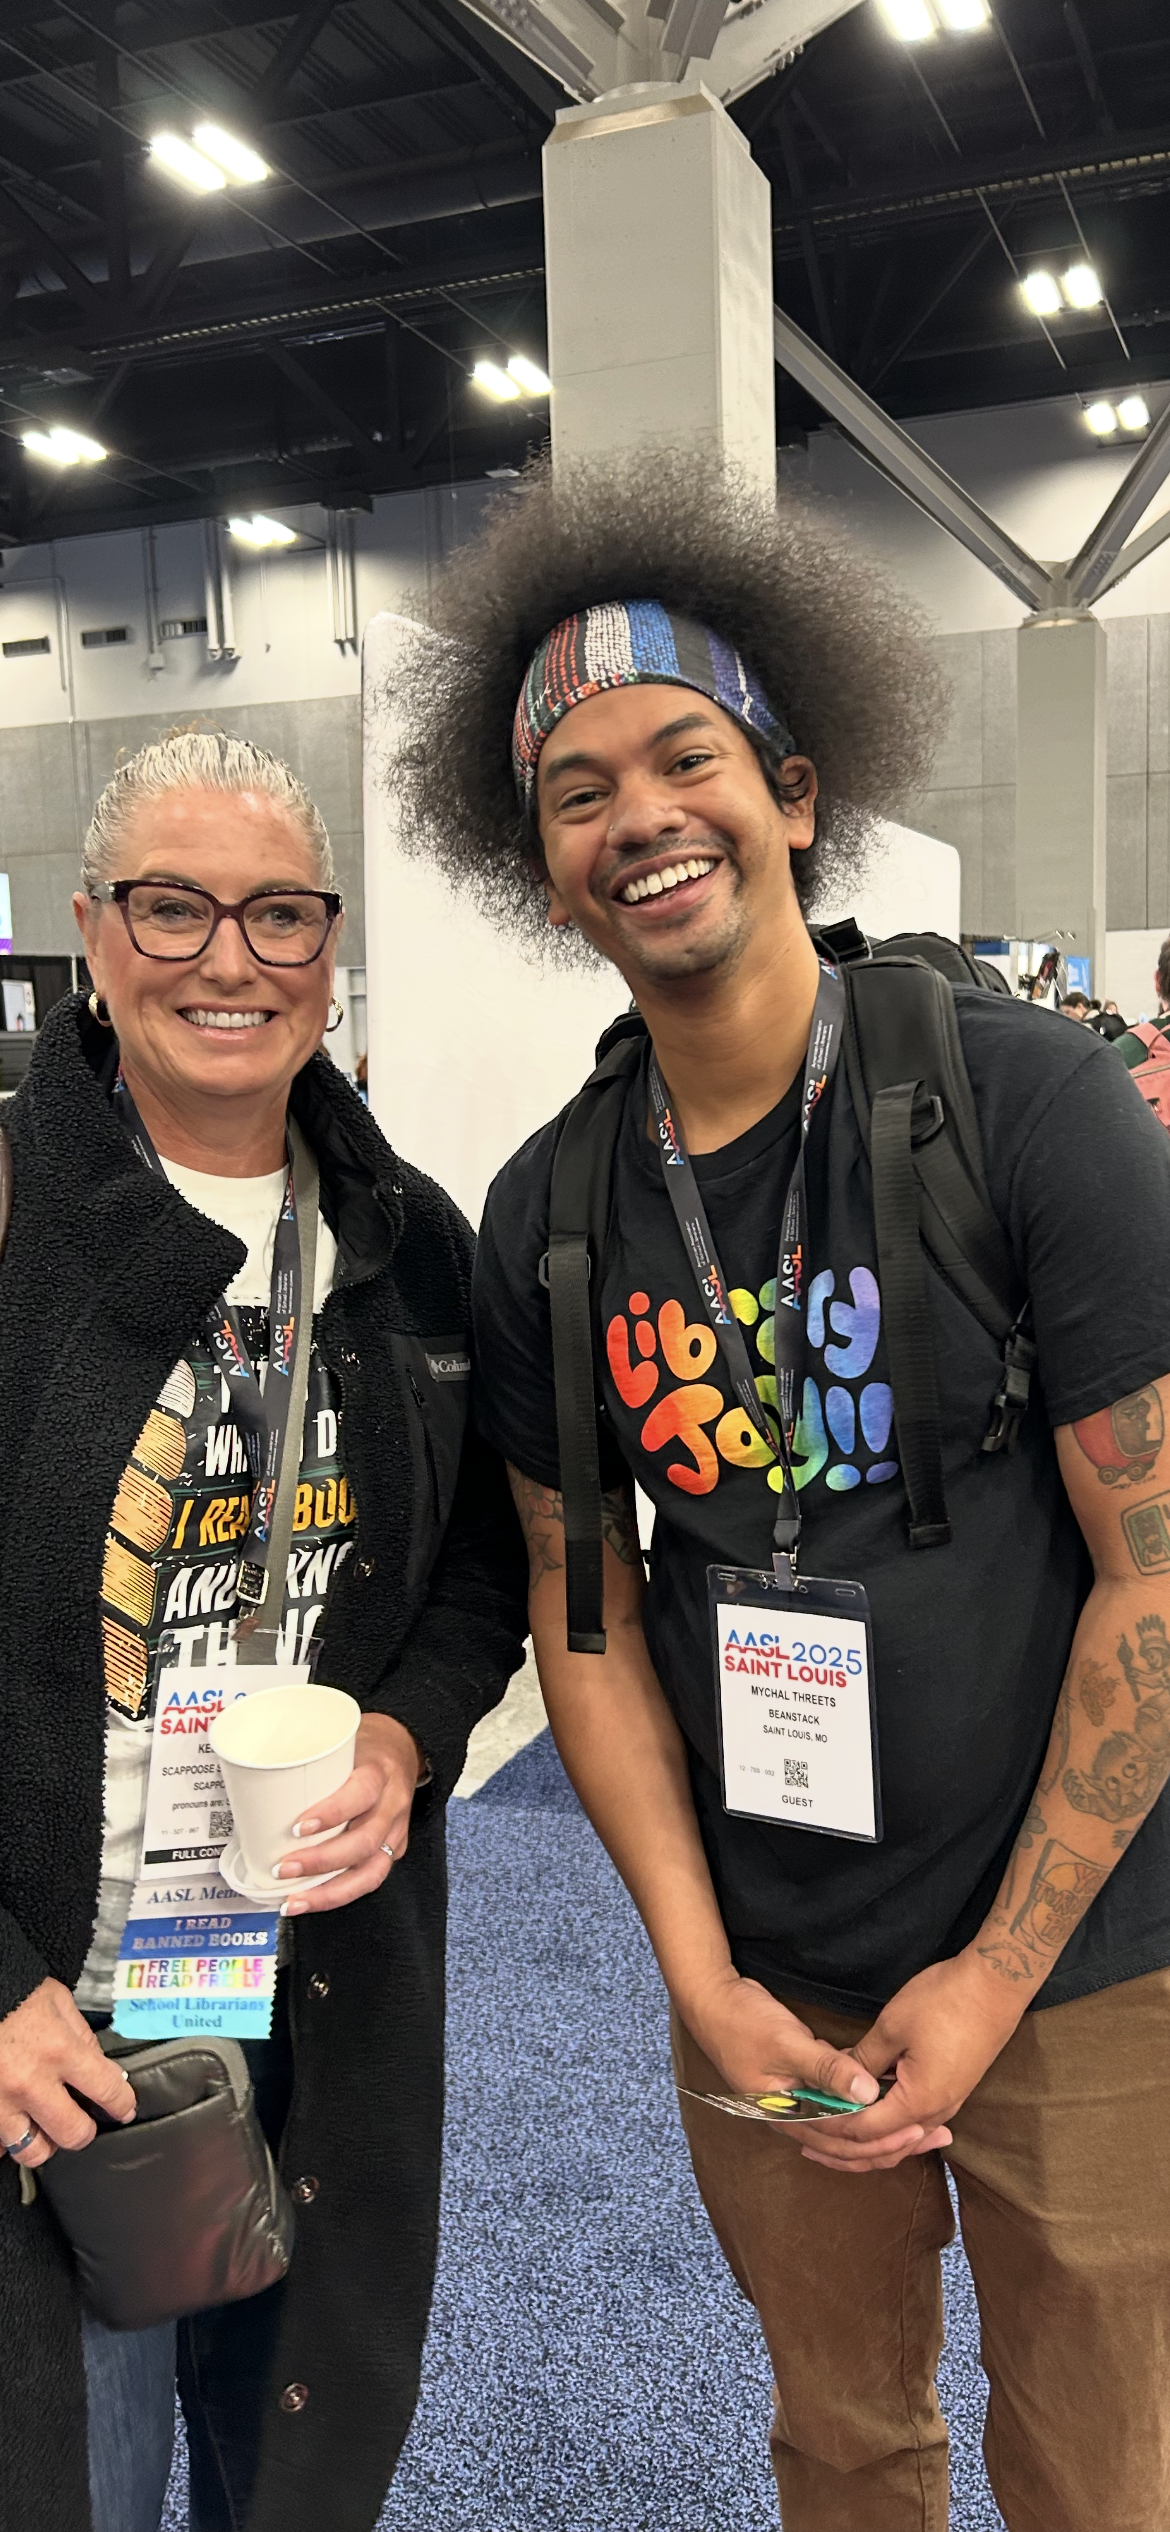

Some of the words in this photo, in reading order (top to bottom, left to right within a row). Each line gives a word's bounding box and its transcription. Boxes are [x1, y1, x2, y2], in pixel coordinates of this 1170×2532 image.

[658, 1108, 685, 1165] AASL
[781, 1244, 802, 1311] AASL
[702, 1264, 732, 1325] AASL
[213, 1319, 250, 1378] AASL
[272, 1316, 295, 1377] AASL
[253, 1479, 276, 1543] AASL
[172, 1499, 195, 1549] I
[199, 1495, 250, 1547] REA
[724, 1629, 790, 1660] AASL
[792, 1642, 863, 1675] 2025
[725, 1655, 782, 1679] SAINT
[787, 1664, 848, 1688] LOUIS
[162, 1689, 226, 1715] AASL
[751, 1685, 790, 1702] MYCHAL
[792, 1691, 837, 1708] THREETS
[769, 1708, 821, 1726] BEANSTACK
[763, 1724, 786, 1738] SAINT
[787, 1729, 814, 1741] LOUIS,
[815, 1732, 828, 1744] MO
[162, 1764, 216, 1777] SCAPPOOSE
[193, 1779, 226, 1791] SCAPPO
[172, 1801, 208, 1812] pronouns
[781, 1794, 814, 1808] GUEST
[172, 1850, 198, 1861] FULL
[199, 1847, 224, 1858] CON
[147, 1887, 195, 1904] AASL
[173, 1919, 183, 1931] I
[185, 1916, 232, 1930] READ
[132, 1934, 206, 1950] BANNED
[208, 1931, 268, 1947] BOOKS
[148, 1959, 192, 1973] FREE
[196, 1958, 263, 1973] PEOPLE
[146, 1974, 193, 1988] READ
[197, 1973, 263, 1988] FREELY
[128, 1997, 180, 2012] School
[185, 1997, 266, 2011] Librarians
[172, 2014, 223, 2028] United
